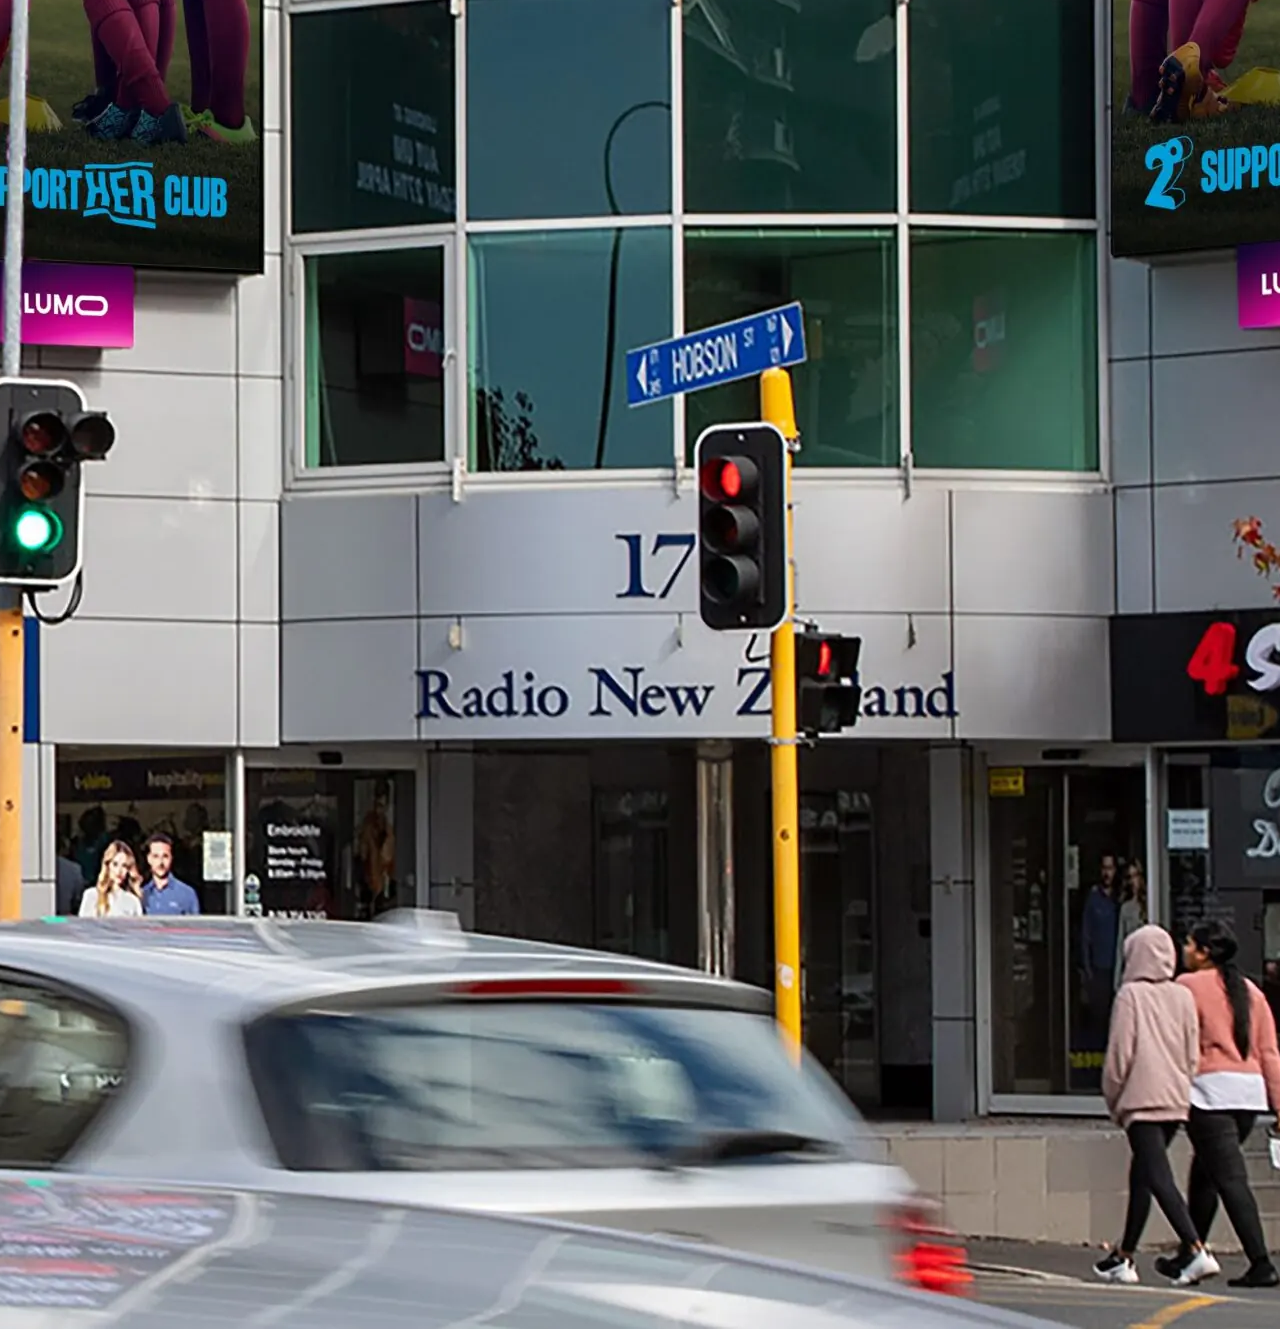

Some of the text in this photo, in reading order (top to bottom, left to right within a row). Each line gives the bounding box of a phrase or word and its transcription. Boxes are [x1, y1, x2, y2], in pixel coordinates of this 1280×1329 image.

[164, 174, 228, 218] CLUB
[23, 292, 109, 317] LUMO
[671, 332, 739, 386] HOBSON
[743, 326, 755, 349] ST
[1187, 622, 1240, 696] 4
[414, 668, 570, 720] Radio
[588, 666, 715, 718] New
